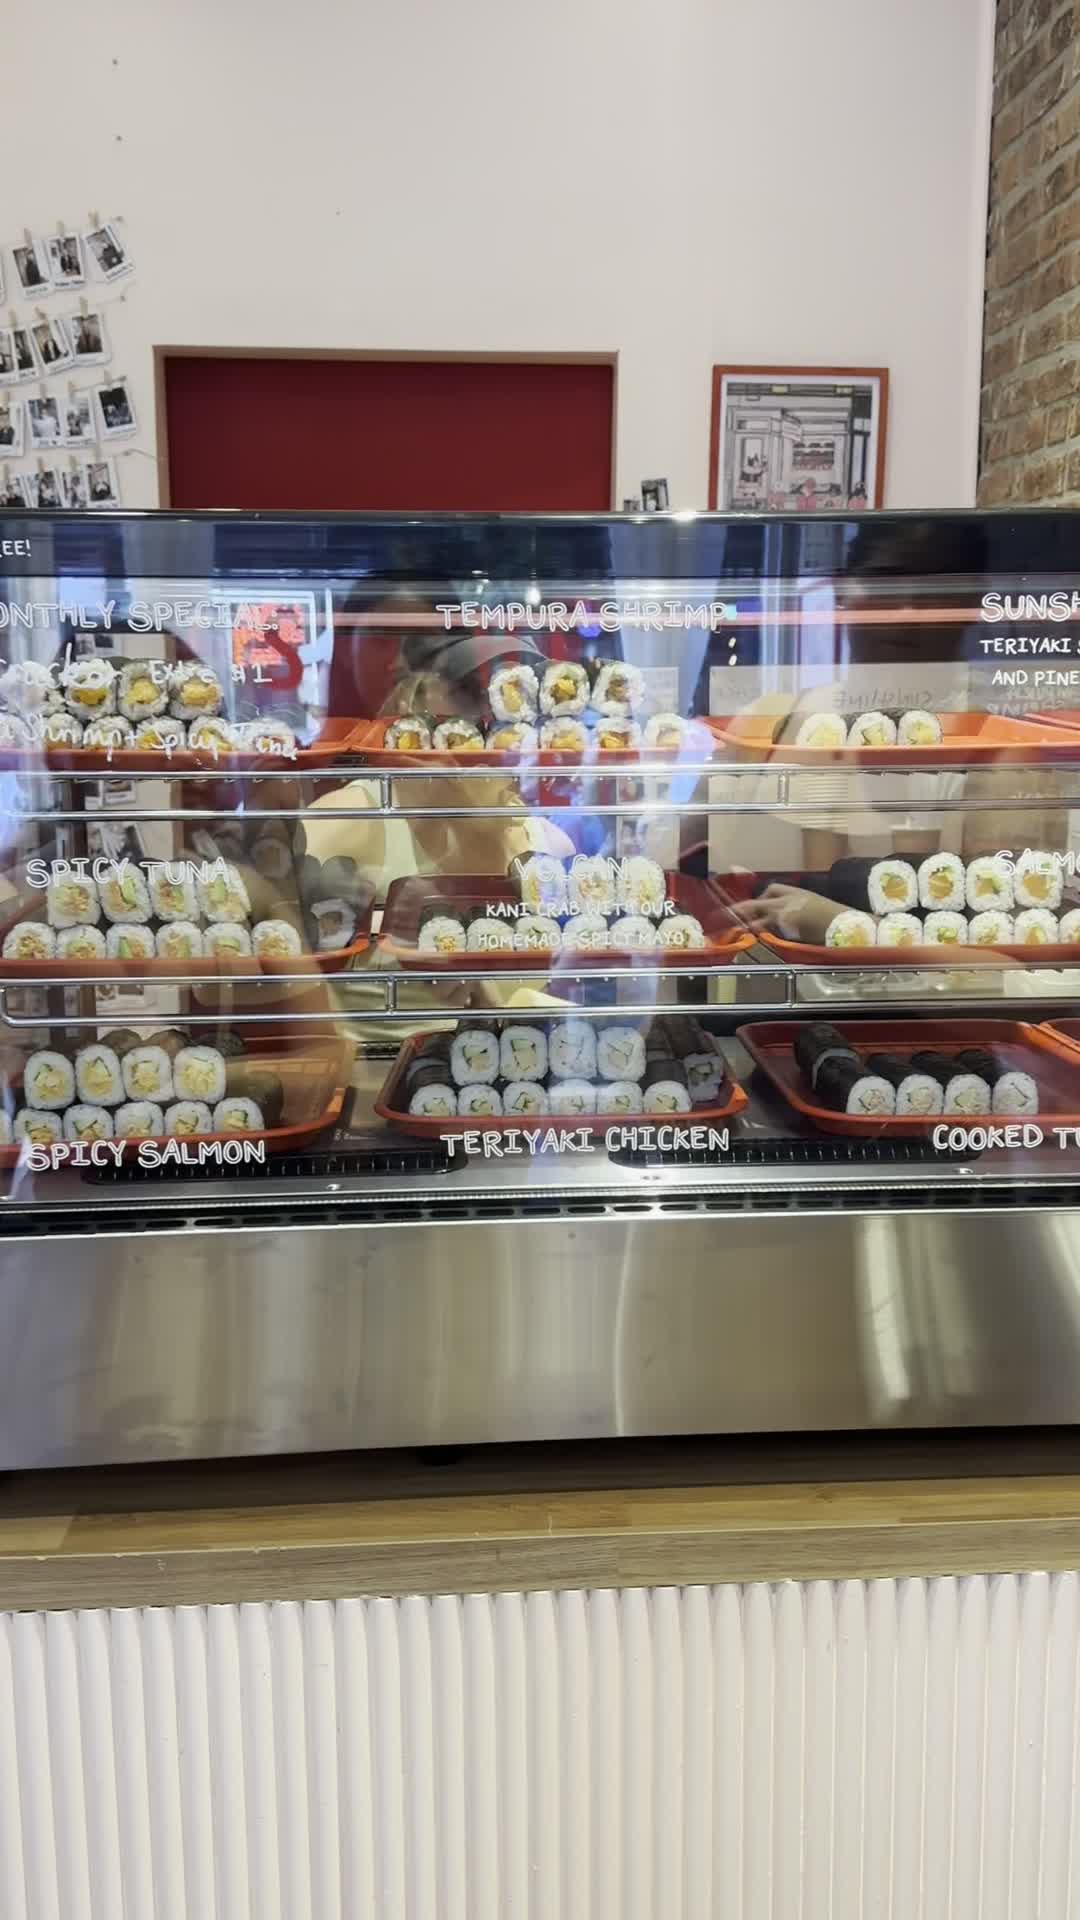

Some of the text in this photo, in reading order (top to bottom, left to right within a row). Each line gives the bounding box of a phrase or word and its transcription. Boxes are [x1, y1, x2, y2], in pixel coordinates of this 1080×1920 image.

[0, 539, 32, 557] EE!
[435, 600, 727, 632] TEMPURA SHRIMP
[979, 637, 1072, 655] TERIYAKI
[991, 669, 1080, 687] AND PINE
[26, 857, 232, 888] SPICY TUNA
[485, 900, 677, 917] KANI CRAB WITH OUR
[638, 930, 685, 947] MAYO
[440, 1126, 730, 1158] TERIYAKI CHICKEN
[932, 1123, 1080, 1151] COOKED T
[27, 1138, 266, 1172] SPICY SALMON
